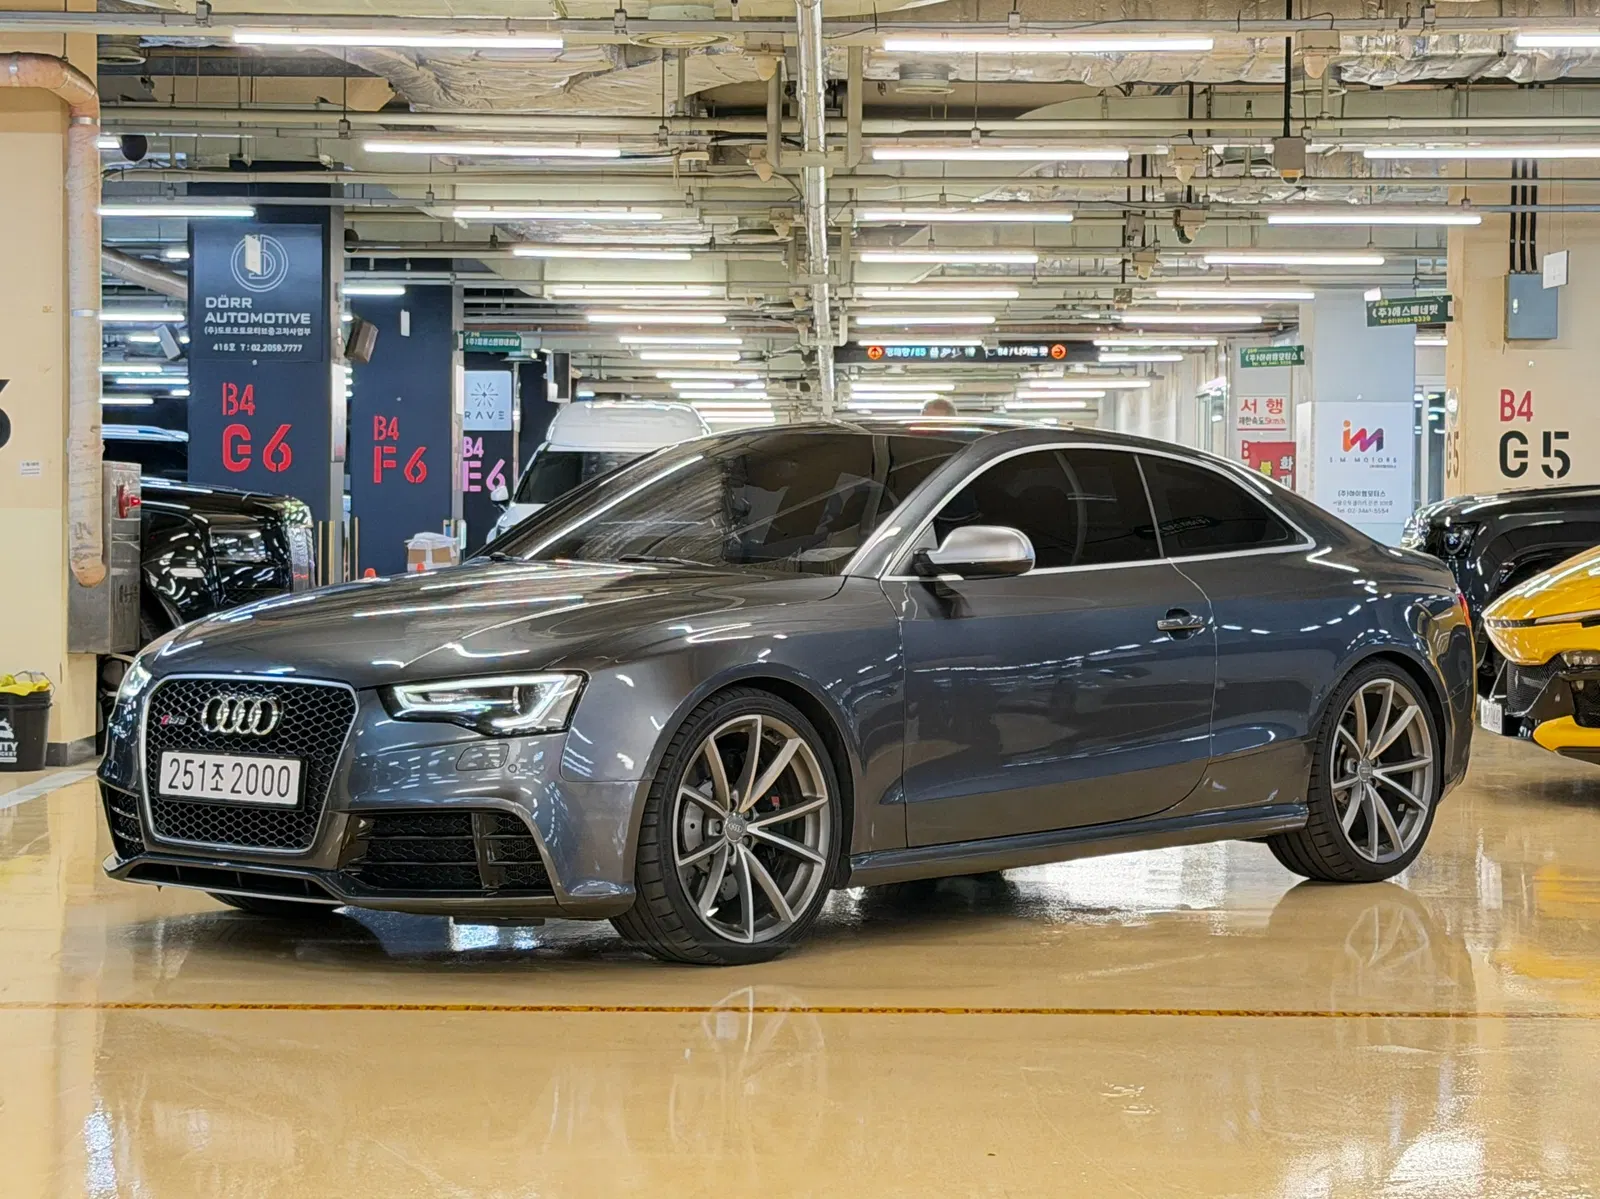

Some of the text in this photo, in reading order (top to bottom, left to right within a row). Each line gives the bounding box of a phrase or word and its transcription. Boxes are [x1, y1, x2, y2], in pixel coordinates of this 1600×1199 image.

[205, 294, 252, 309] DÖRR
[204, 312, 311, 324] AUTOMOTIVE
[222, 382, 256, 416] B4
[1500, 389, 1533, 422] B4
[464, 411, 505, 419] RAVE
[374, 415, 399, 441] B4
[463, 436, 484, 458] B4
